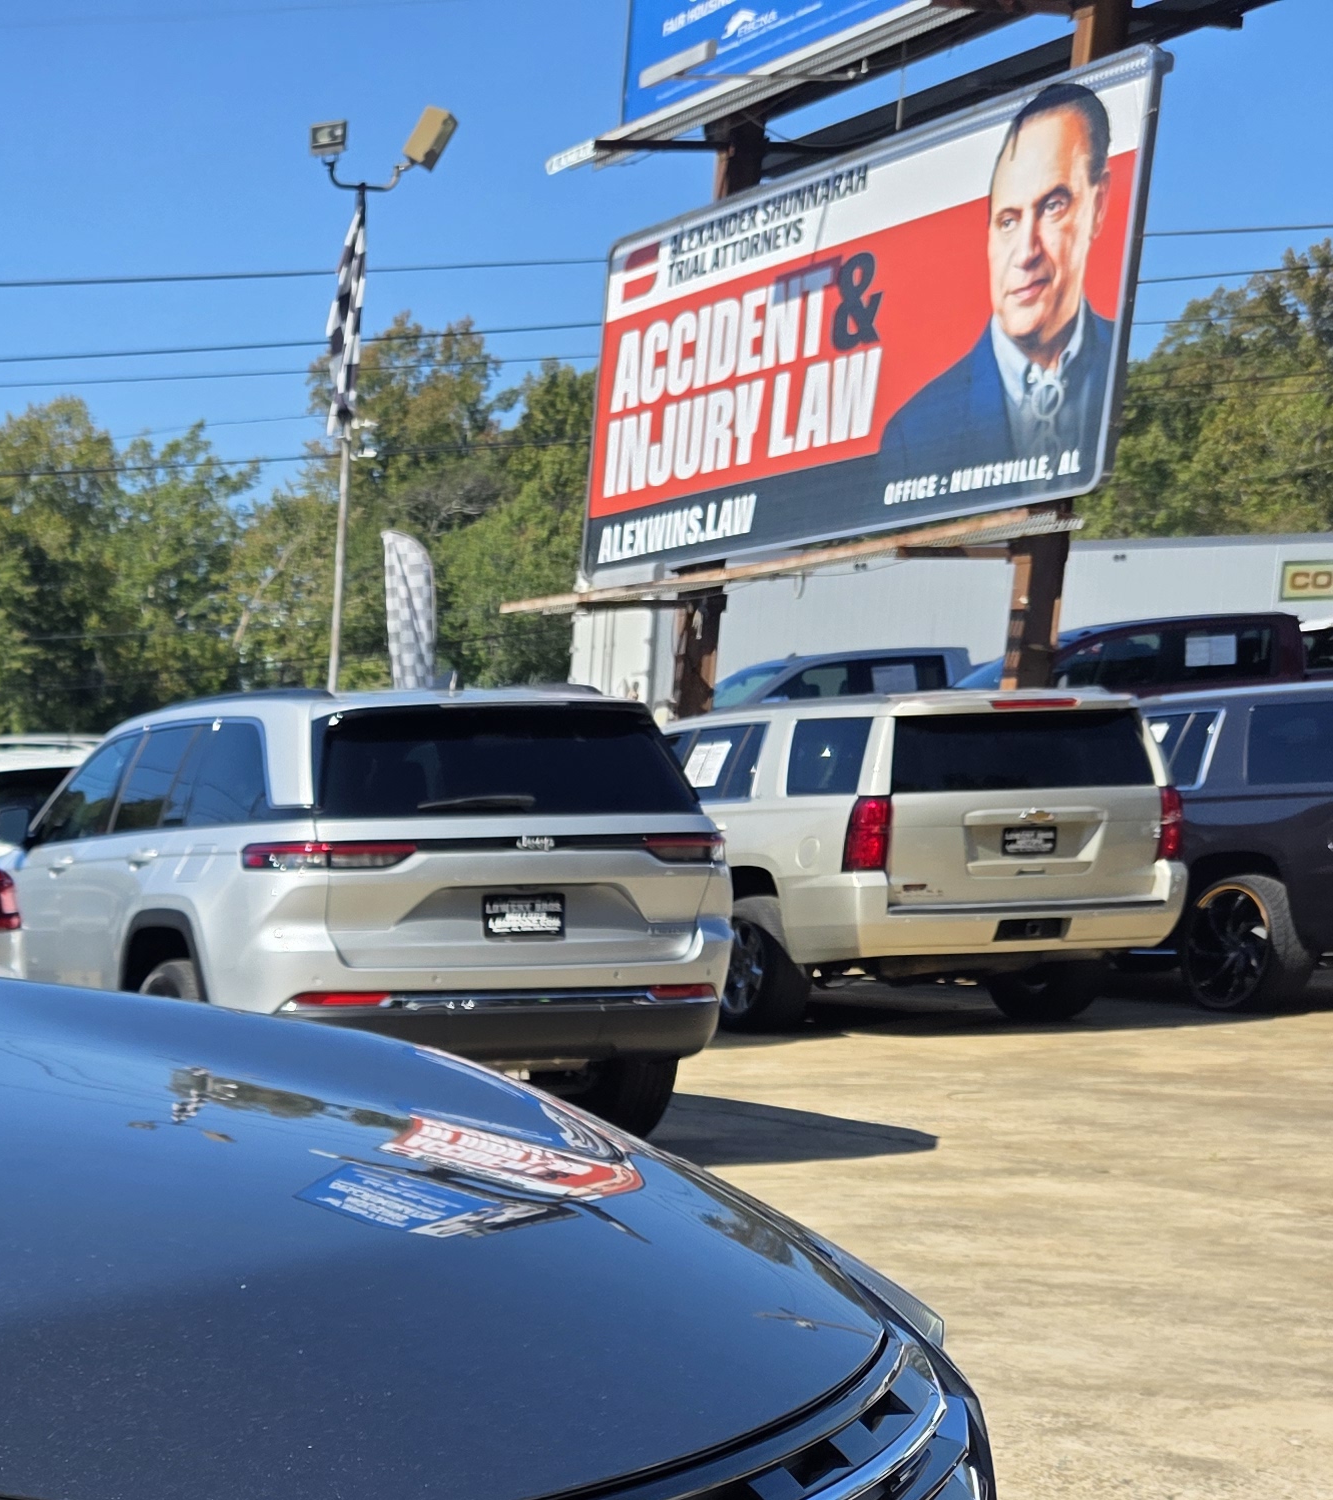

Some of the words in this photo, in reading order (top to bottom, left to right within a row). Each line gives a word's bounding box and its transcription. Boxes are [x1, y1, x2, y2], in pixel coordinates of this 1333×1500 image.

[668, 200, 758, 254] ALEXANDER
[760, 164, 869, 223] SHUNNARAH
[668, 251, 707, 287] TRIAL
[708, 217, 804, 271] ATTORNEYS
[611, 266, 832, 413] ACCIDENT
[831, 251, 883, 350] &
[603, 379, 766, 498] INJURY
[768, 347, 882, 458] LAW
[884, 474, 939, 505] OFFICE
[1058, 447, 1081, 475] AL
[597, 493, 758, 564] ALEXWINS.LAW
